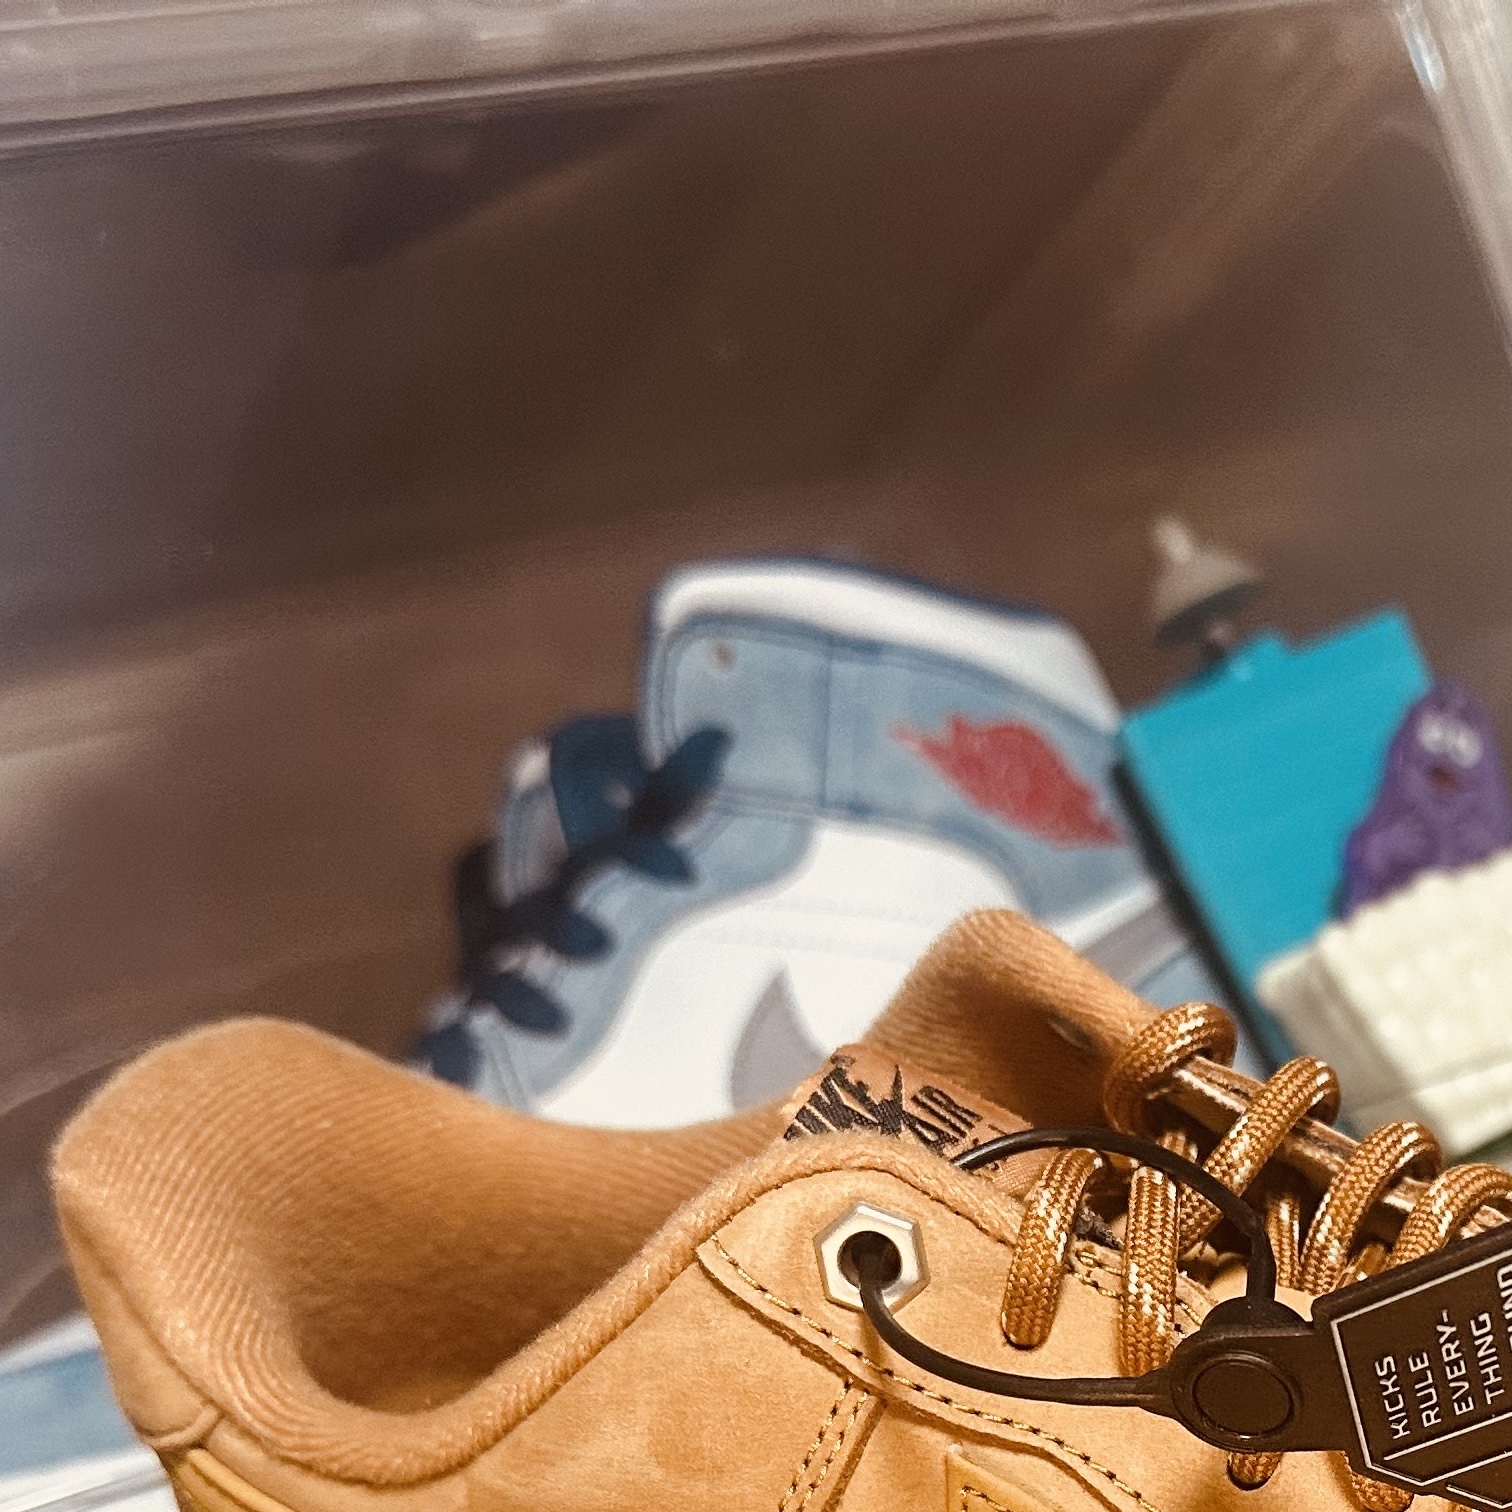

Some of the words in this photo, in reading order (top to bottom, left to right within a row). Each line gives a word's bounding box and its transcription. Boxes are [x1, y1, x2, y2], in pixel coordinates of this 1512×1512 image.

[784, 1055, 880, 1140] IKE
[1375, 1355, 1411, 1440] KICKS
[1408, 1351, 1442, 1429] RULE
[1435, 1308, 1476, 1416] EVERY-
[1470, 1311, 1506, 1405] THING
